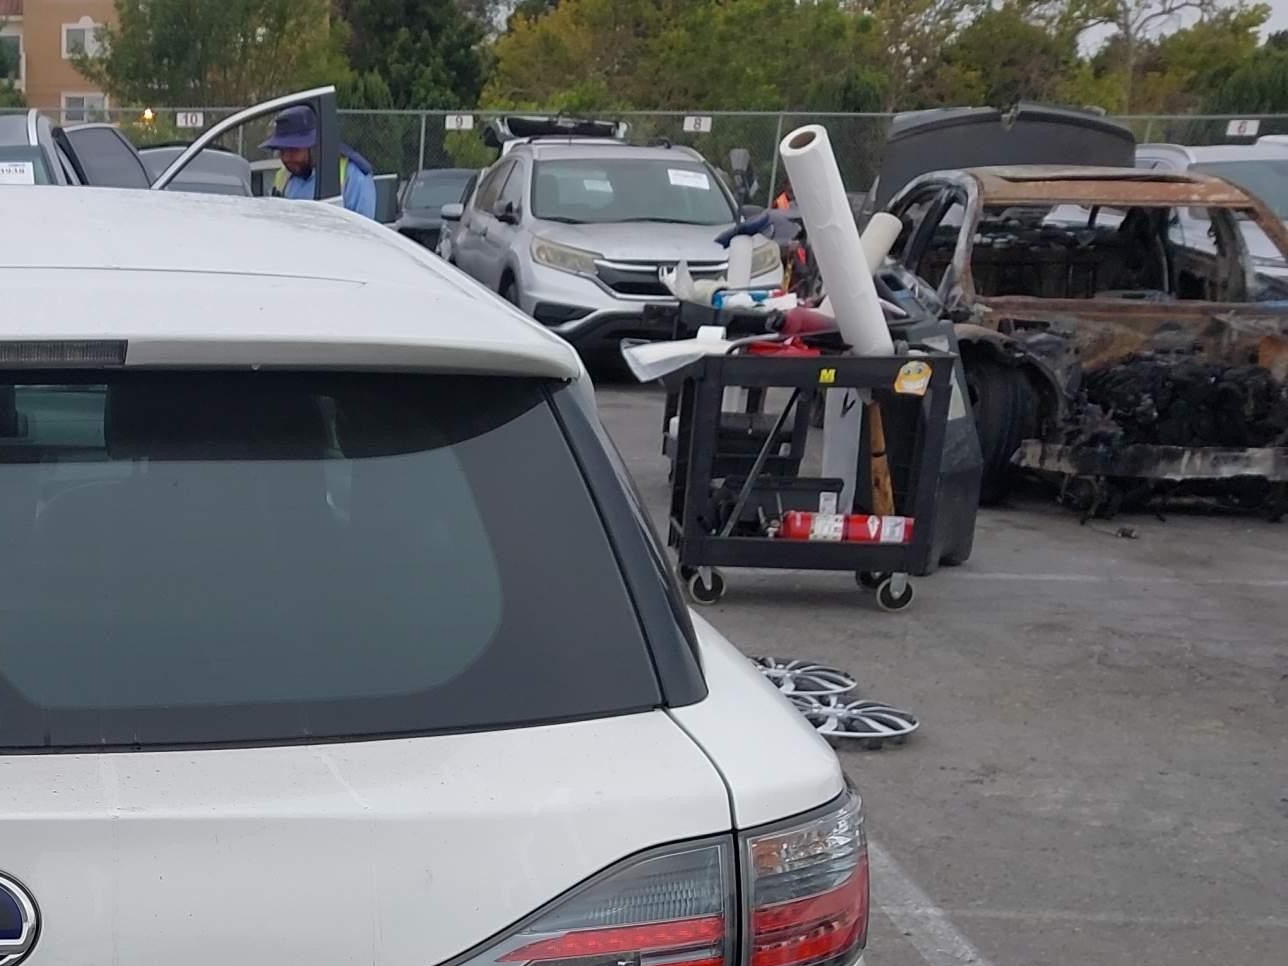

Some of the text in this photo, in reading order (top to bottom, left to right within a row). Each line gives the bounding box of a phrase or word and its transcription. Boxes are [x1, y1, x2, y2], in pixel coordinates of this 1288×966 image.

[184, 113, 198, 125] 10
[455, 115, 463, 128] 9
[693, 117, 702, 130] 8
[1238, 120, 1248, 133] 6
